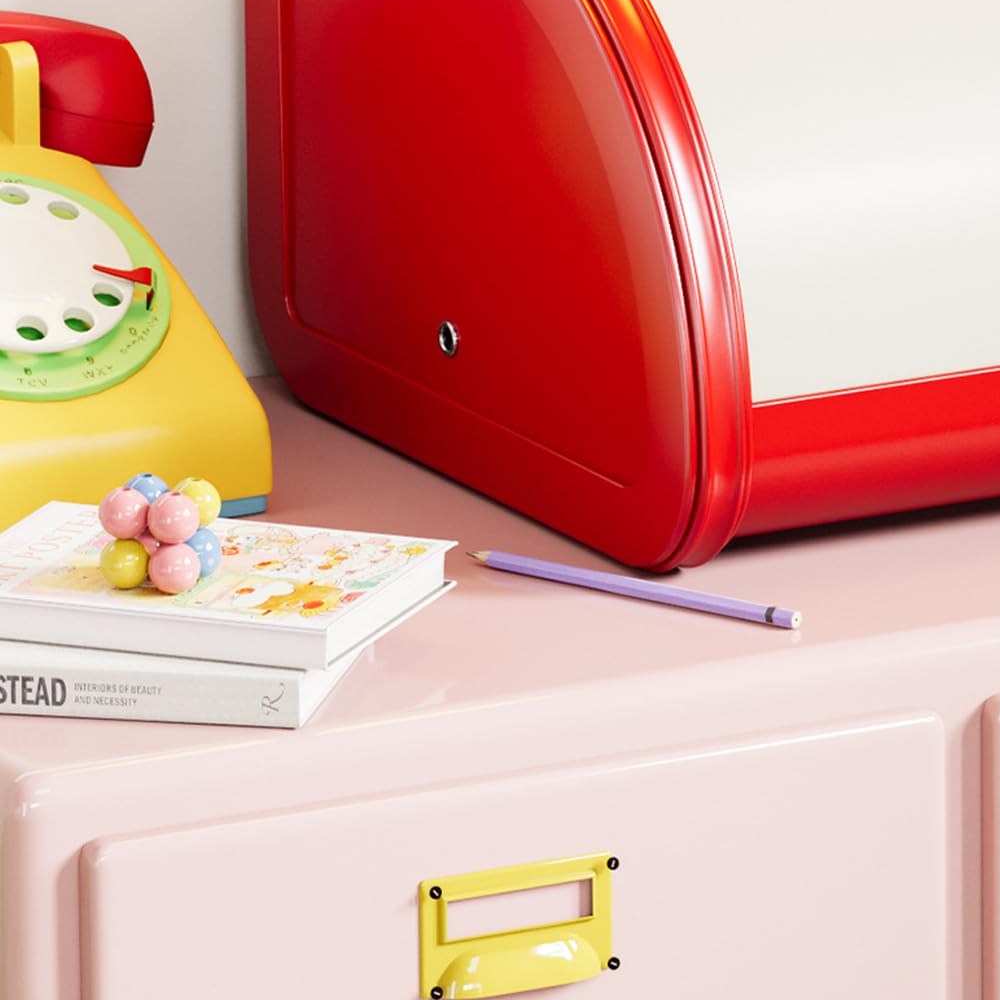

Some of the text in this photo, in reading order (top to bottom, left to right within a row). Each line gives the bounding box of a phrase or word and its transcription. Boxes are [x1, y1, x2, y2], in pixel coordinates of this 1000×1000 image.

[74, 682, 162, 696] INTERIORS OF BEAUTY
[74, 695, 138, 707] AND NECESSITY
